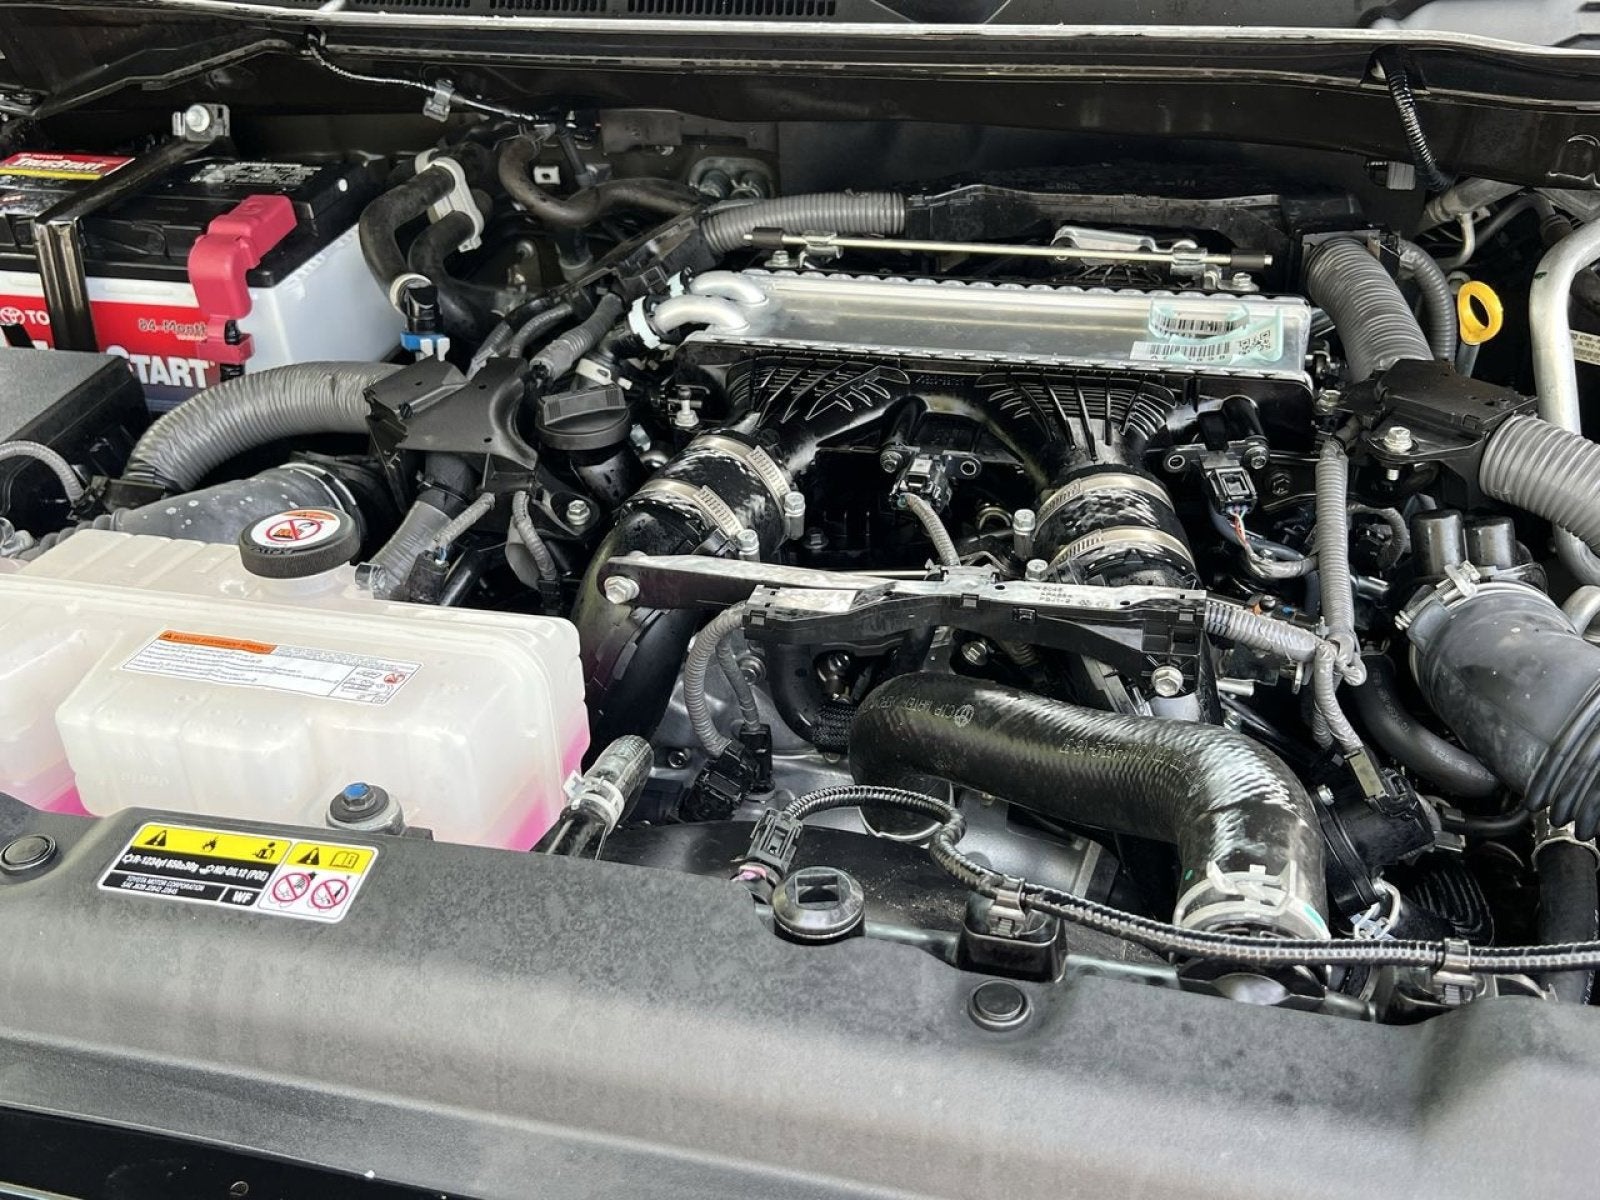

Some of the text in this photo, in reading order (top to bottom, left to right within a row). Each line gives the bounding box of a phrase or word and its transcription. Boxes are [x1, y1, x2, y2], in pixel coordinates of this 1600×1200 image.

[147, 877, 167, 887] MOTOR
[167, 879, 206, 891] CORPORATION
[232, 891, 253, 903] WF
